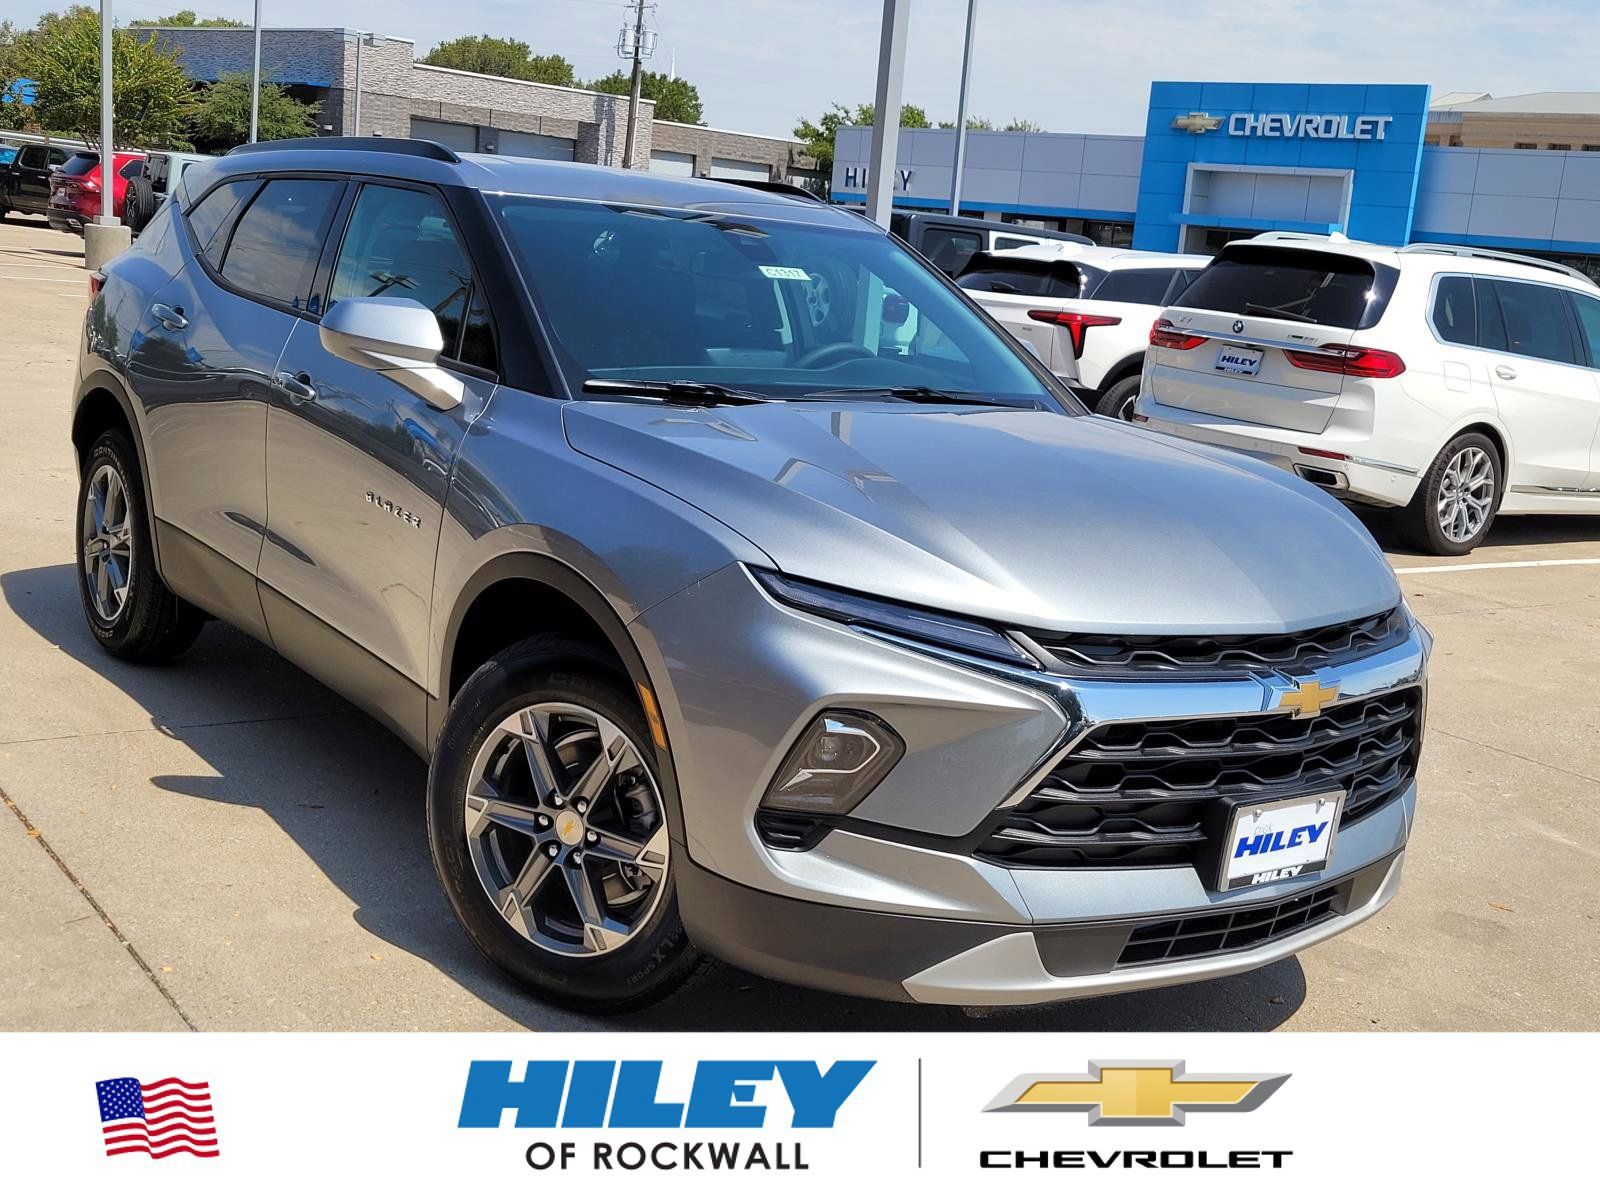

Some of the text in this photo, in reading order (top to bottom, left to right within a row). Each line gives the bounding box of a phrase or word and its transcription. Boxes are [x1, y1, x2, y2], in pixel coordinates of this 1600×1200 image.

[1228, 113, 1393, 140] CHEVROLET
[845, 167, 912, 191] HIY
[765, 268, 802, 278] C1317
[1220, 354, 1258, 367] HILEY
[365, 491, 422, 529] BLAZER
[1234, 821, 1329, 858] HILEY
[1251, 865, 1304, 885] HILEY
